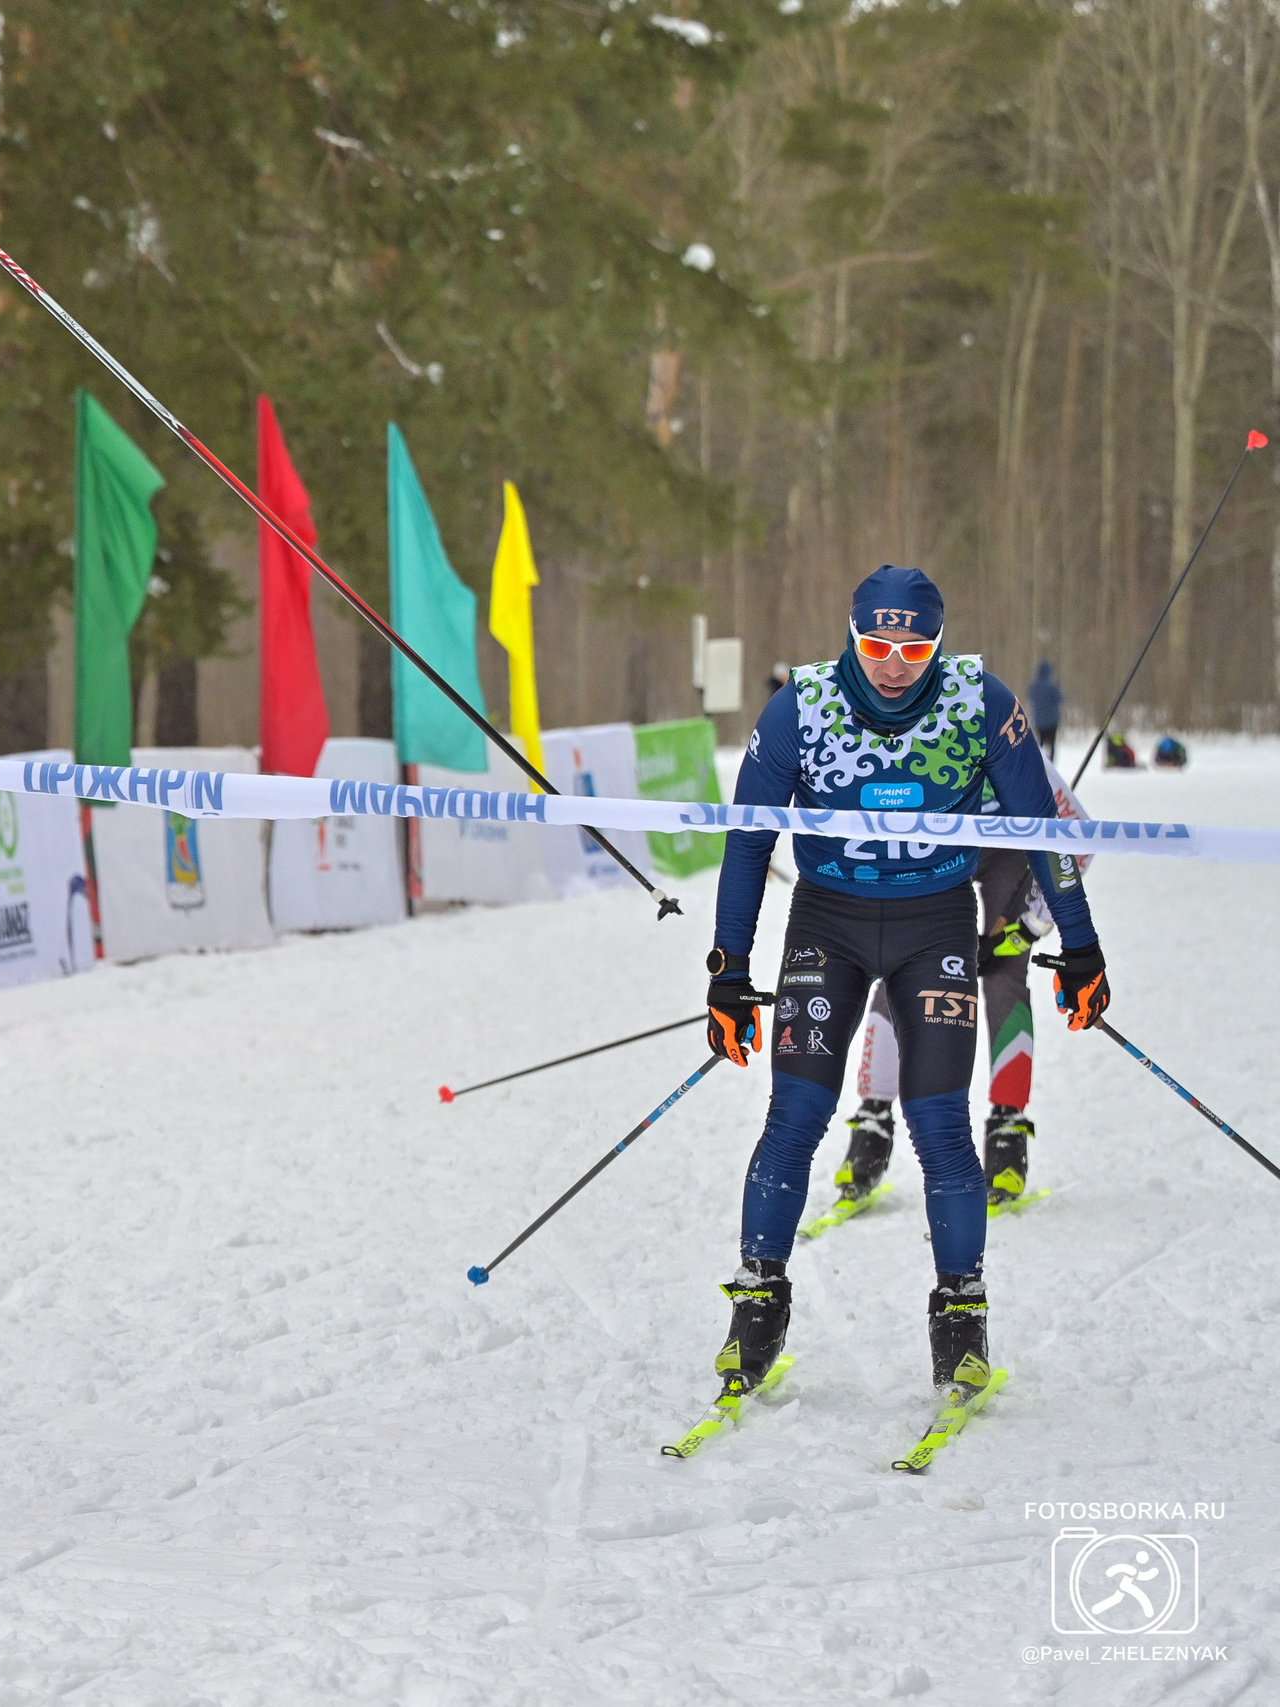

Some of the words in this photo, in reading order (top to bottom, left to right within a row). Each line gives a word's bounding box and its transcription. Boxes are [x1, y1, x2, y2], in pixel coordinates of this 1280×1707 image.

[872, 608, 919, 627] TST
[873, 788, 912, 796] TIMING
[917, 989, 979, 1021] TST
[943, 1017, 957, 1025] SKI
[958, 1020, 975, 1028] TEAM
